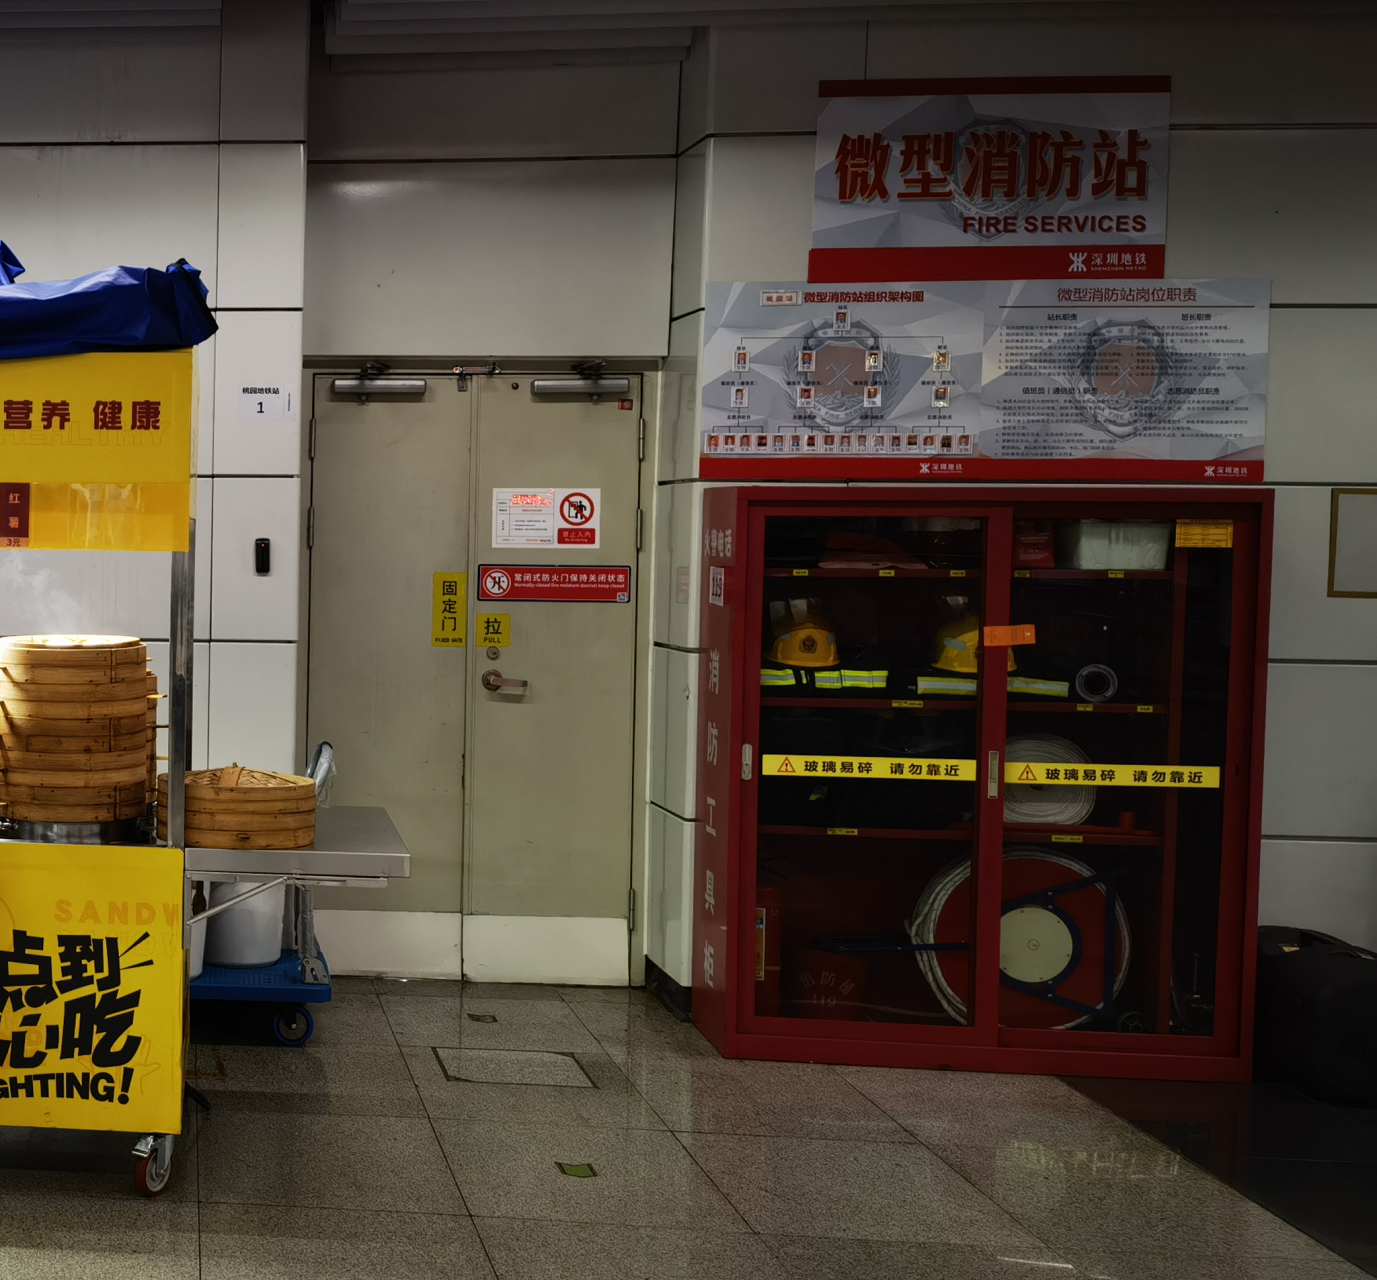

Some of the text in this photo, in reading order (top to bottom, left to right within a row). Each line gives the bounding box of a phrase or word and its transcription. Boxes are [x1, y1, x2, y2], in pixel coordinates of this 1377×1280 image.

[834, 129, 1150, 203] 微型消防站
[962, 214, 1147, 234] FIRE SERVICES
[1091, 252, 1147, 265] 深圳地铁
[804, 290, 925, 303] 微型消防站组织架构图
[1057, 286, 1198, 302] 微型消防站岗位职责
[242, 387, 280, 395] 桃园地铁站
[4, 400, 70, 430] 营养
[93, 400, 161, 430] 健康
[256, 401, 264, 413] 1
[9, 493, 21, 529] 红薯
[7, 538, 21, 547] 3元
[514, 573, 625, 582] 常闭式防火门保持关闭状态
[441, 580, 457, 632] 固定门
[484, 618, 502, 635] 拉
[803, 761, 960, 777] 玻璃易碎 请勿靠近
[1045, 767, 1203, 784] 玻璃易碎 请勿靠近
[702, 648, 720, 989] 消防工具柜
